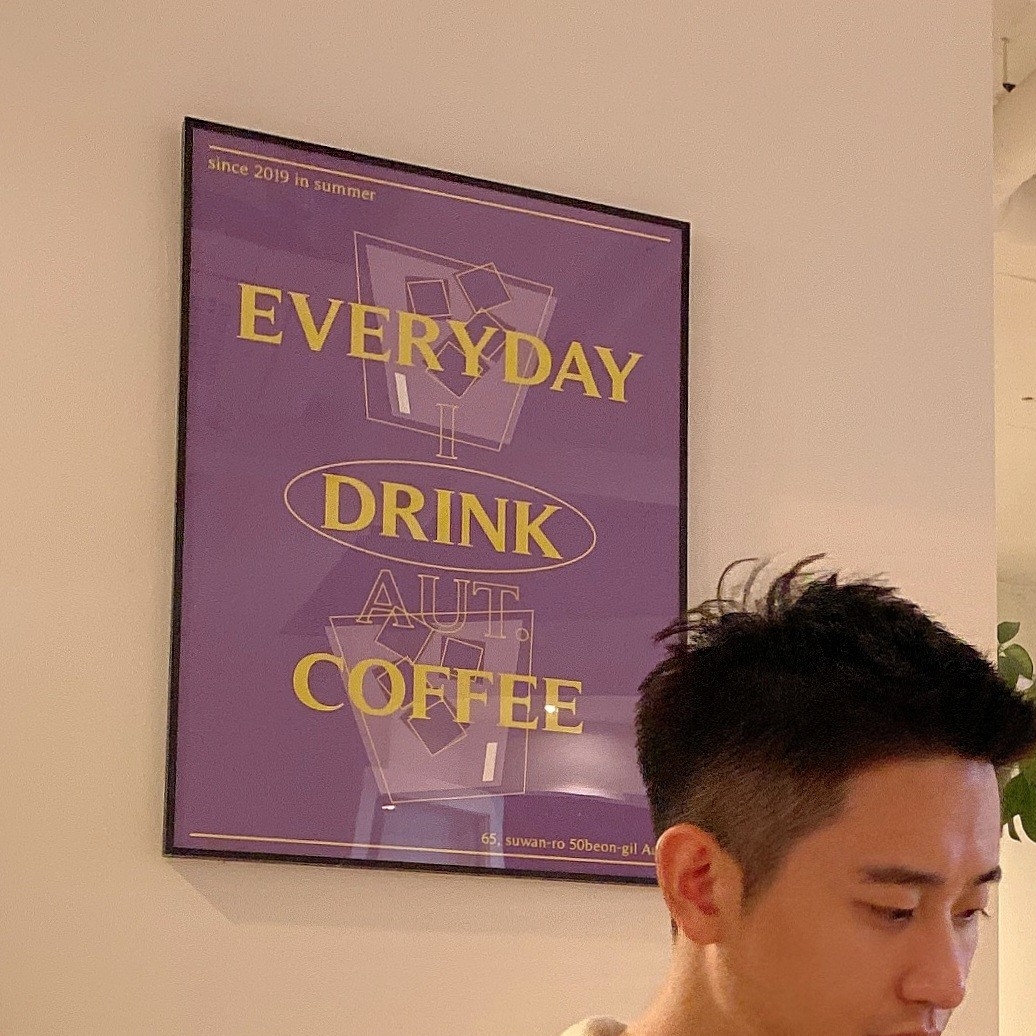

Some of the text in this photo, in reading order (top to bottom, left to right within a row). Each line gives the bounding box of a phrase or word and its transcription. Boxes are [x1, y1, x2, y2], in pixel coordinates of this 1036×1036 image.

[207, 156, 377, 200] since 2019 in summer
[236, 282, 644, 403] EVERYDAY
[321, 472, 563, 560] DRINK
[292, 652, 584, 734] COFFEE
[505, 835, 566, 850] suwan-ro
[569, 837, 638, 857] 50beon-gil
